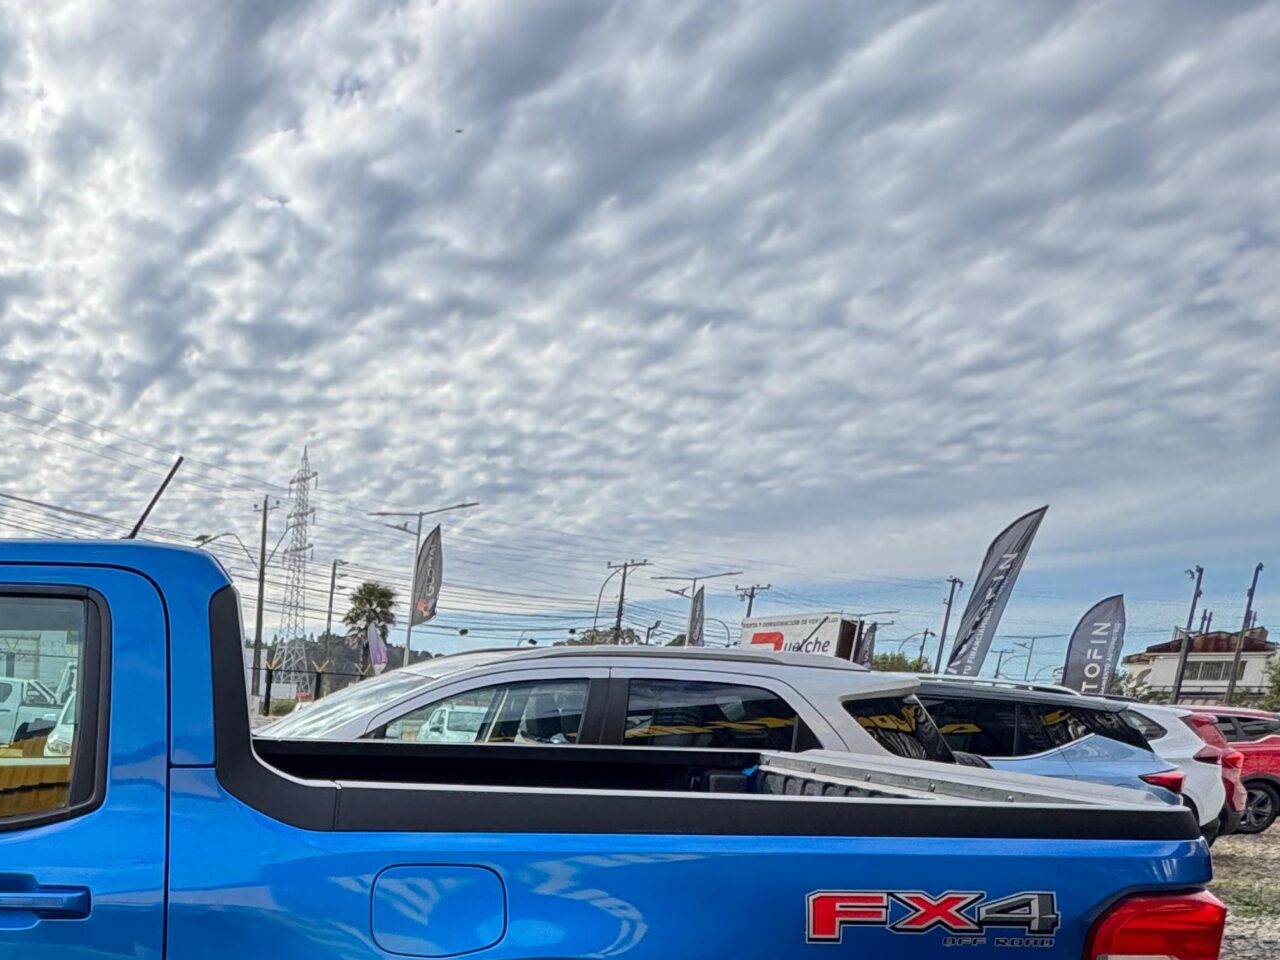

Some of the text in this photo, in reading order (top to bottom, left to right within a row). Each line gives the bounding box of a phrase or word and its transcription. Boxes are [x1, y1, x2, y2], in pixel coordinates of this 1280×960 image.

[806, 889, 1061, 944] FX4
[942, 936, 1055, 948] OFF ROAD
